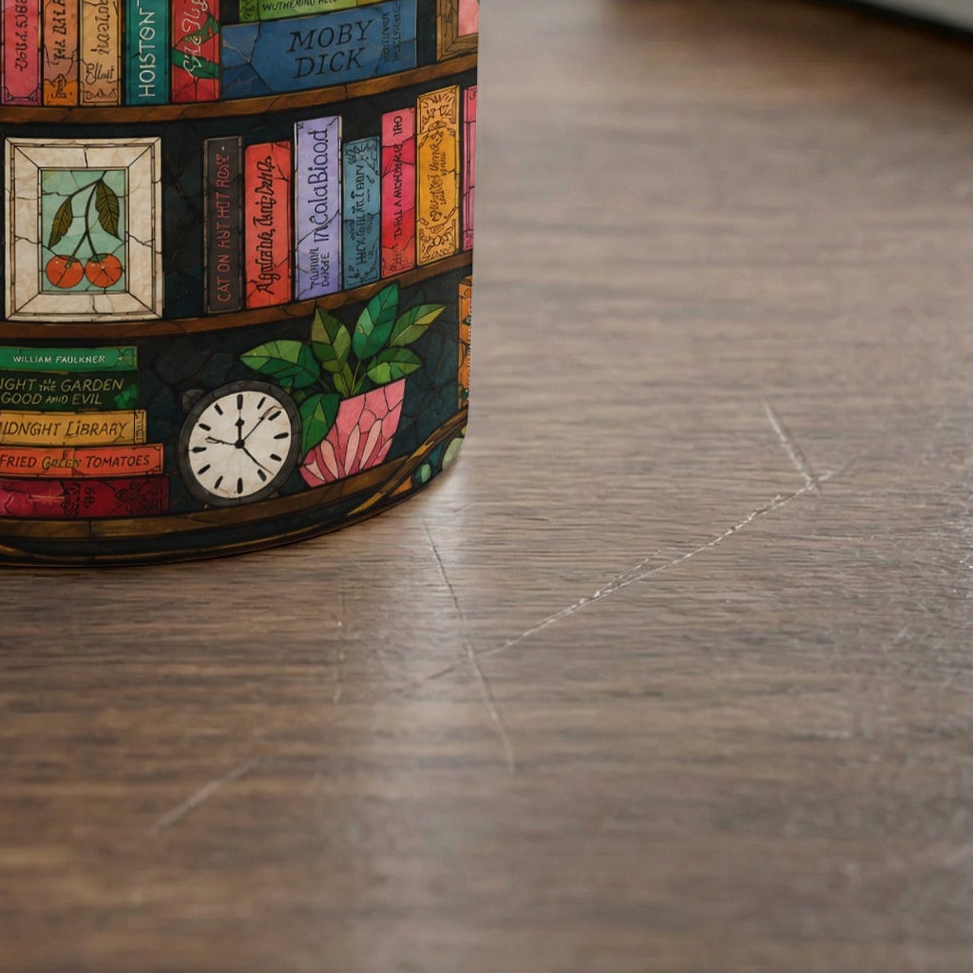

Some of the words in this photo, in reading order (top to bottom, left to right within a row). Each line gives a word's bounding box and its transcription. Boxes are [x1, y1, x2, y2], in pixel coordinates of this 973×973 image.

[285, 18, 376, 53] MOBY
[293, 47, 366, 79] DICK
[216, 253, 231, 273] ON
[216, 274, 231, 303] CAT
[13, 355, 52, 363] WILLIAM
[55, 354, 106, 364] FAULKNER
[61, 378, 124, 392] GARDEN
[1, 391, 43, 405] GOOD
[72, 392, 104, 405] EVIL
[0, 454, 38, 468] FRIED
[85, 454, 150, 468] TOMATOES
